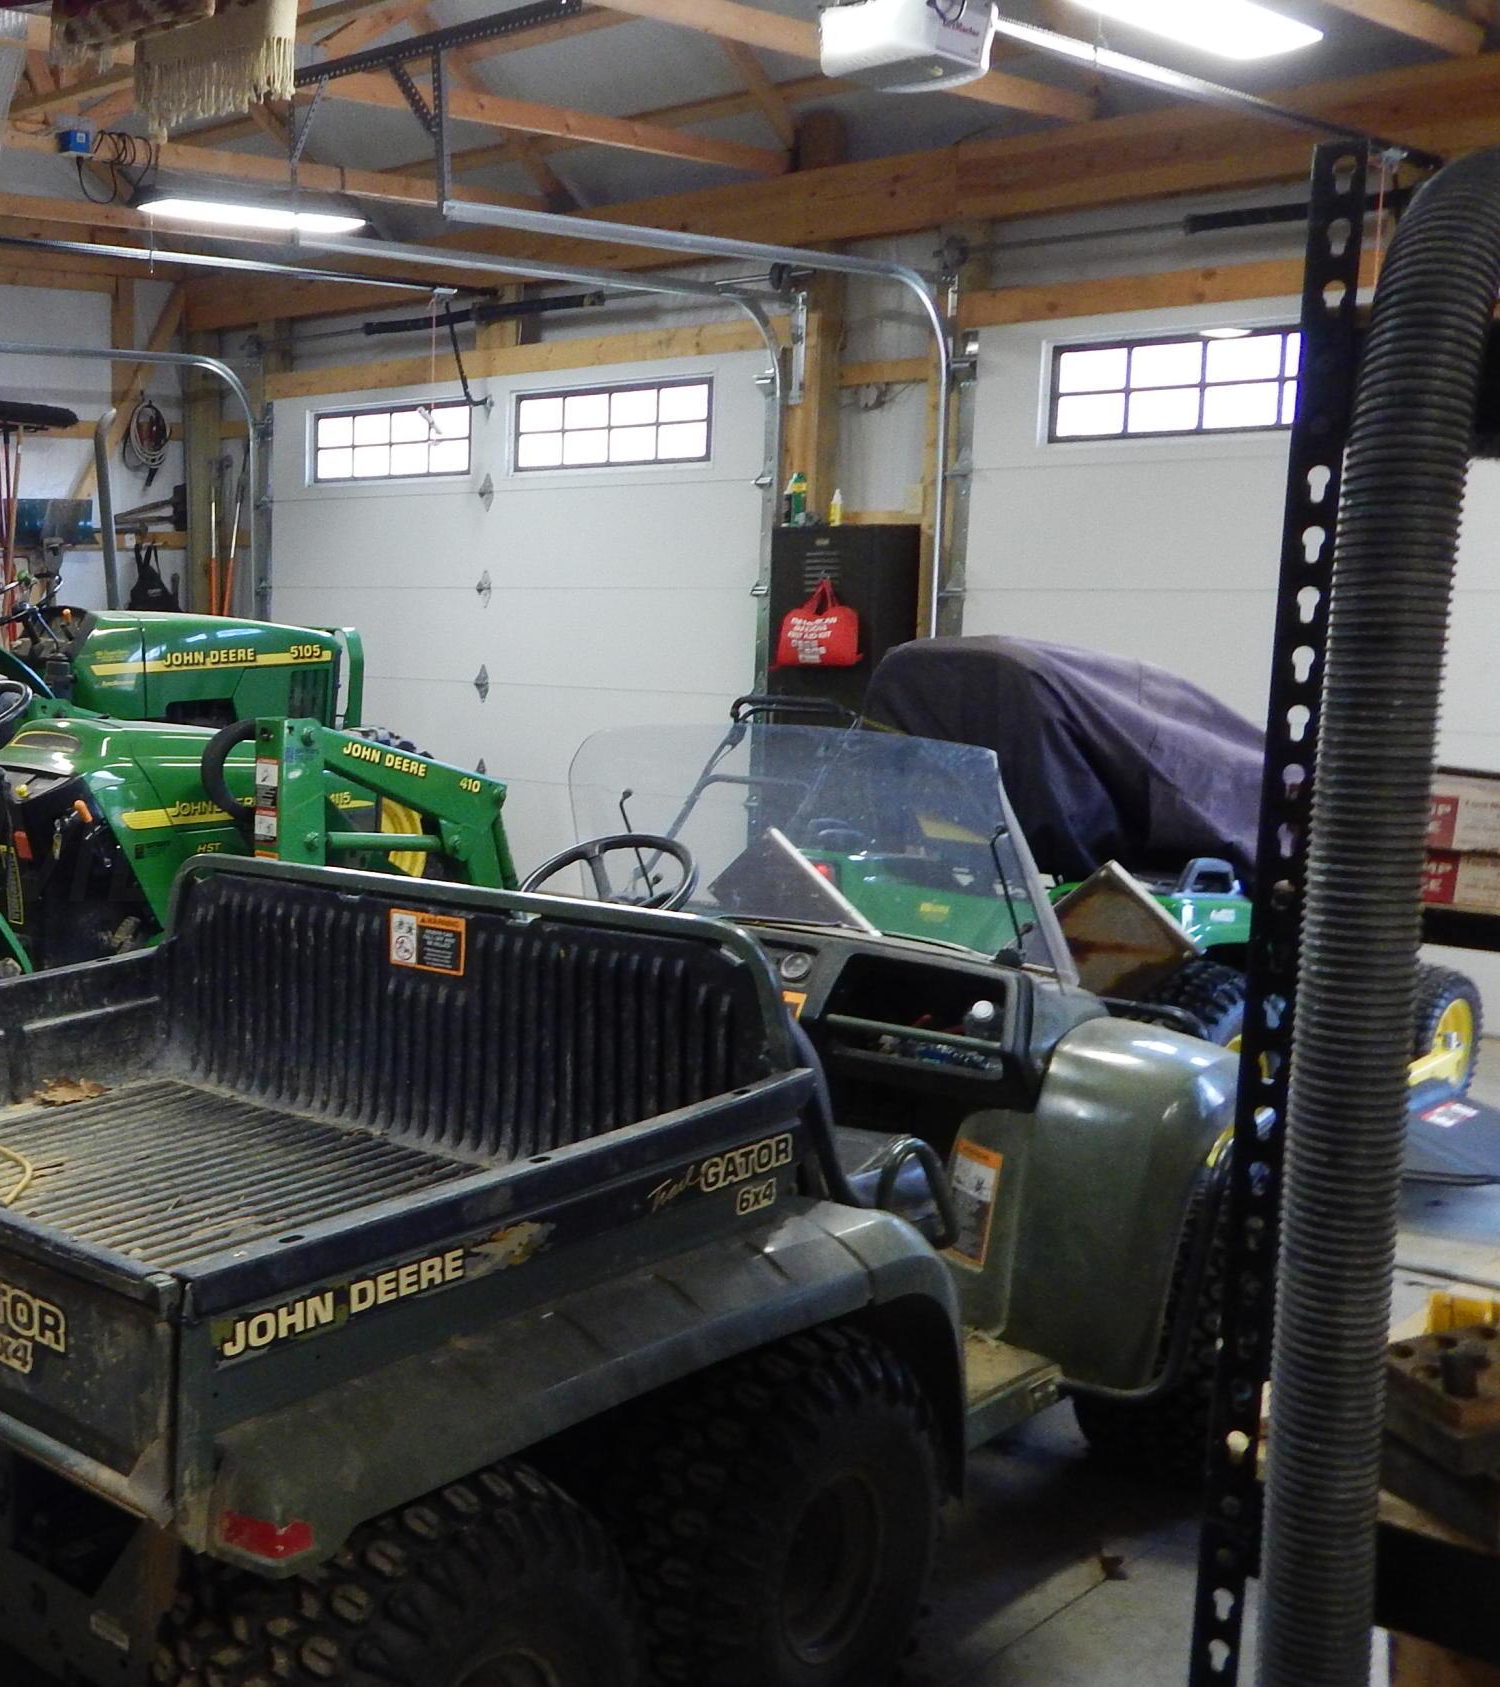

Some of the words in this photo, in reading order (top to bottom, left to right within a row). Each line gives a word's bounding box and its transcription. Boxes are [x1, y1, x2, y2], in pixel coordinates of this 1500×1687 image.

[163, 651, 205, 667] JOHN
[209, 647, 256, 665] DEERE
[289, 644, 322, 660] 5105
[343, 741, 382, 764] JOHN
[384, 752, 428, 778] DEERE
[459, 776, 482, 794] 410
[171, 800, 214, 818] JOHN
[196, 841, 222, 854] HST
[700, 1132, 793, 1193] GATOR
[735, 1176, 777, 1216] 6x4
[222, 1290, 335, 1357] JOHN
[349, 1248, 466, 1315] DEERE
